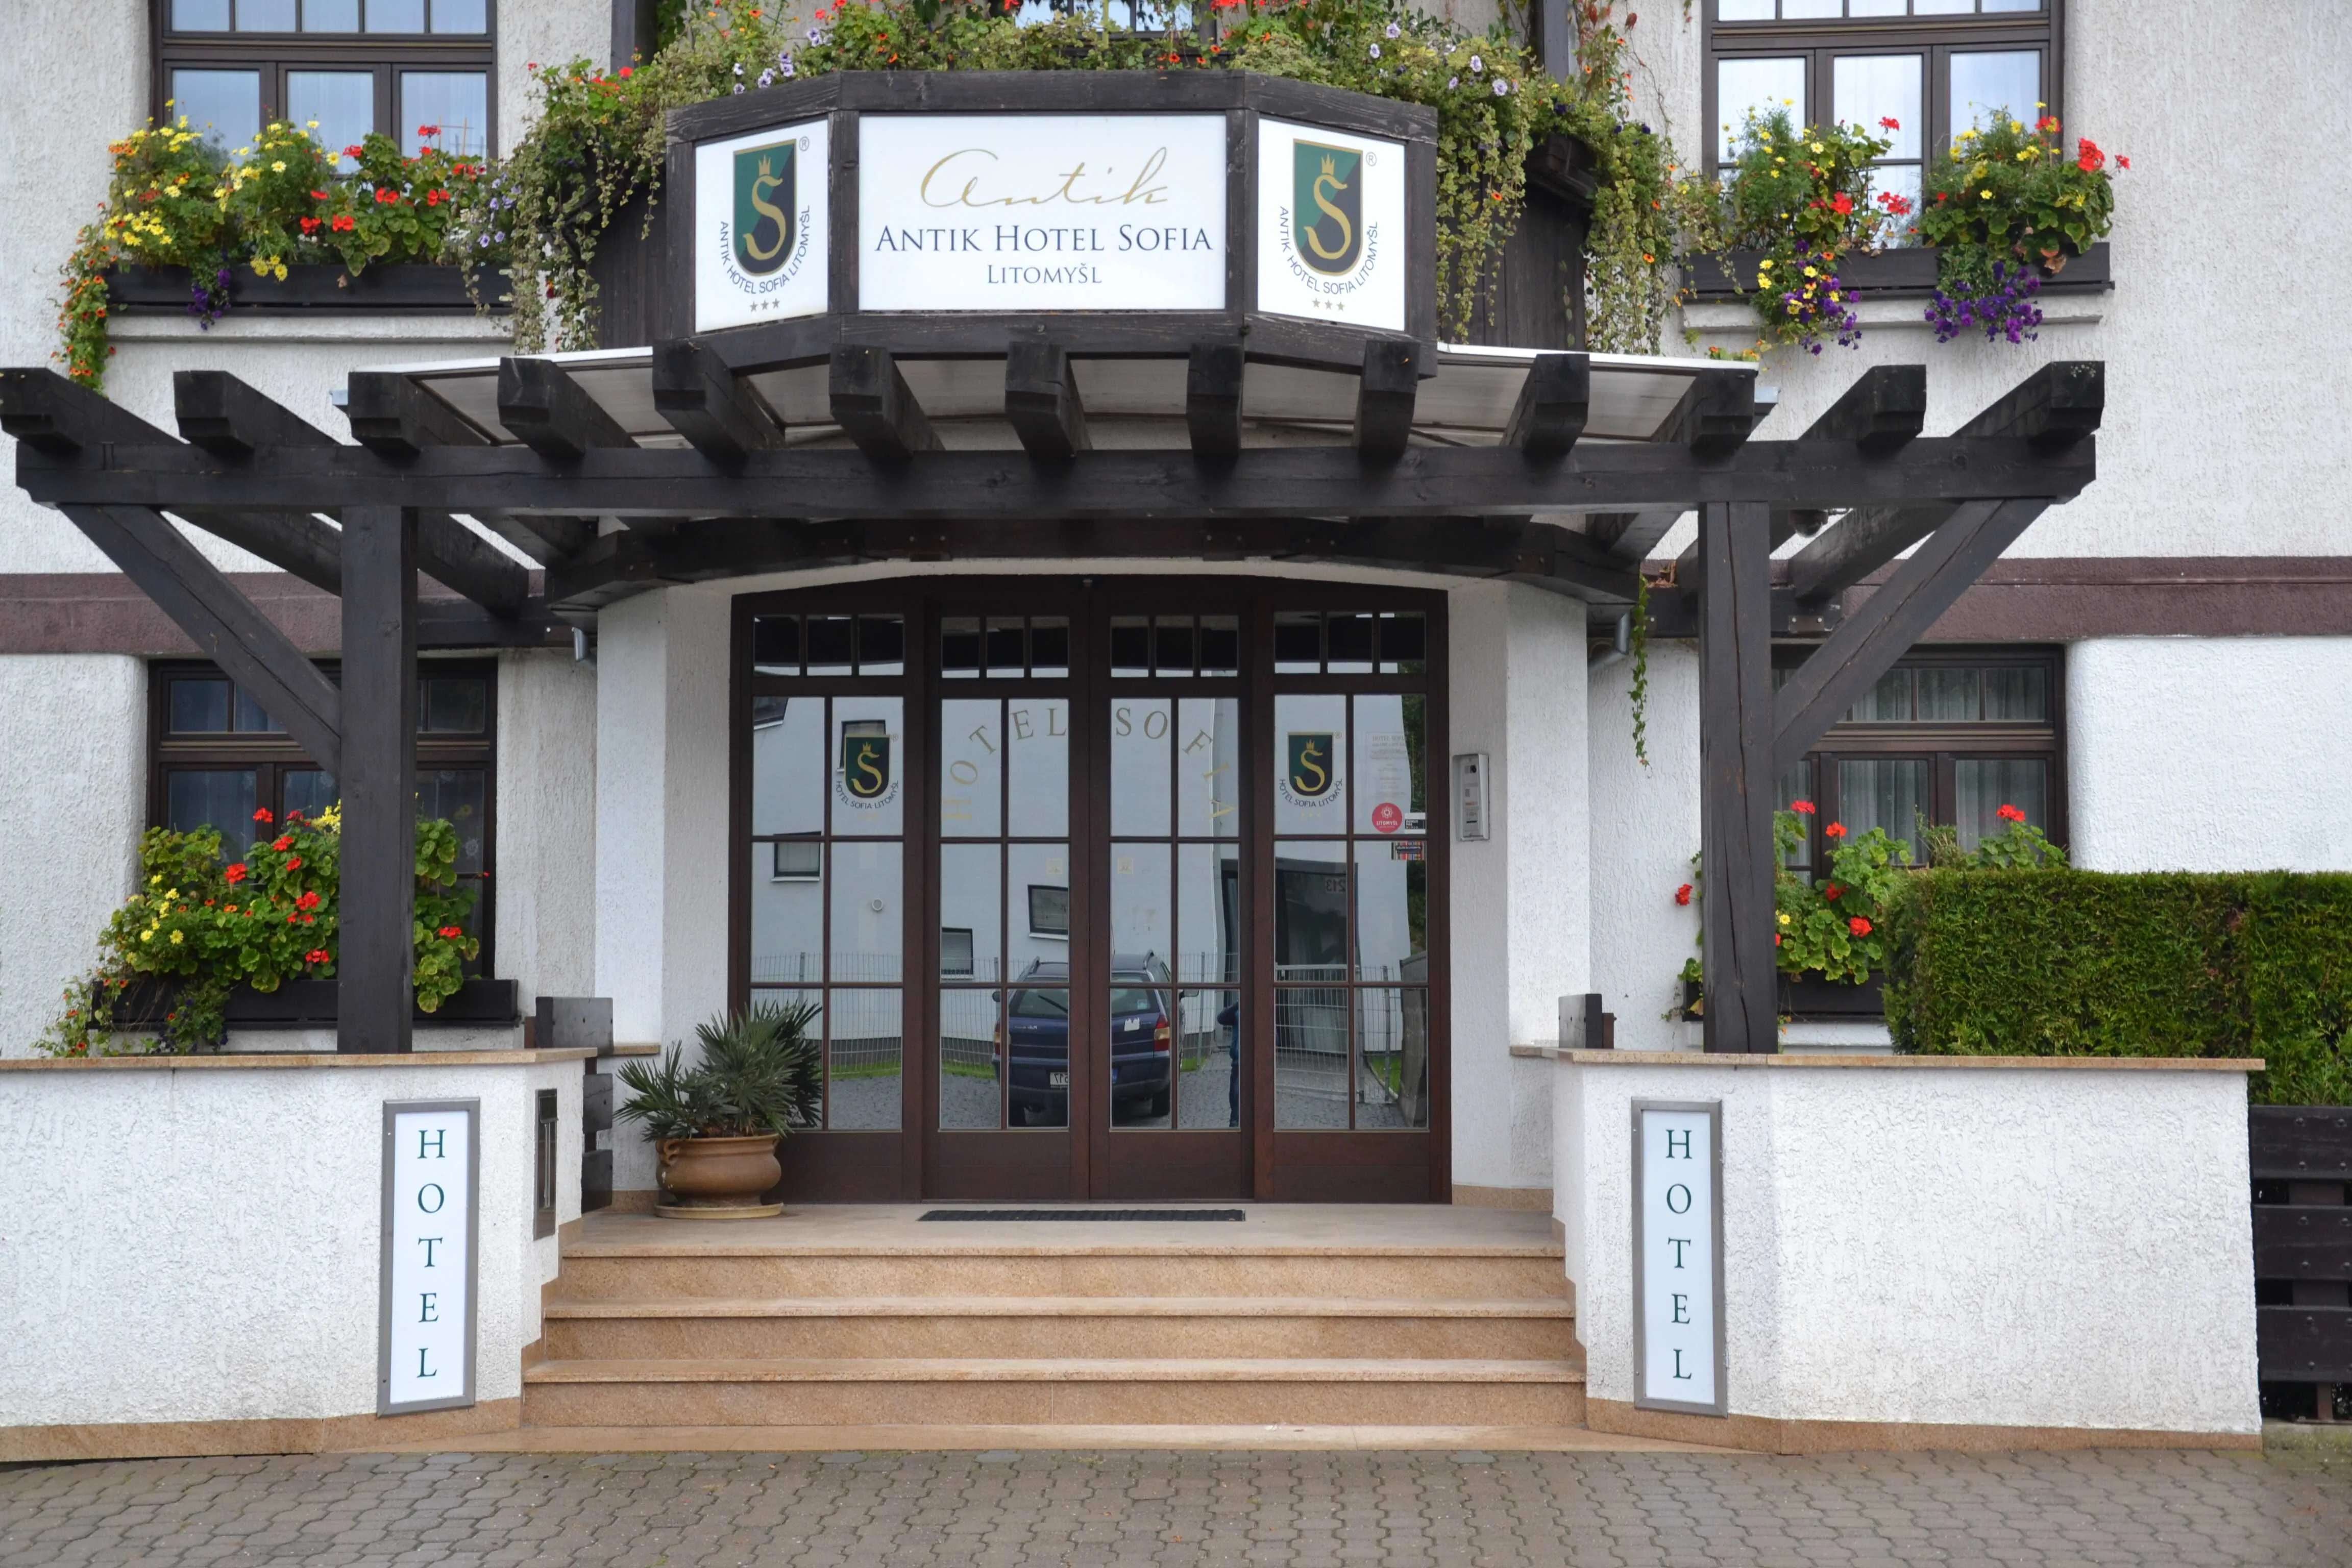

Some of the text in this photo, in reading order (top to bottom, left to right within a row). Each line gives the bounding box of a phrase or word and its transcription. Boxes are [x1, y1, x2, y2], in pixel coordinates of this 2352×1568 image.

[720, 205, 810, 295] ANTIK HOTEL SOFIA LITOMYŠL
[874, 224, 1213, 252] ANTIK HOTEL SOFIA
[987, 263, 1102, 284] LITOMYŠL
[1280, 206, 1378, 295] ANTIK HOTEL SOFIA LITOMYŠL
[836, 781, 849, 805] HOTEL
[850, 800, 872, 809] SOFIA
[942, 708, 1067, 819] HOTEL
[1279, 779, 1293, 803] HOTEL
[1294, 799, 1316, 807] SOFIA
[416, 1129, 447, 1378] HOTEL
[1665, 1129, 1693, 1380] HOTEL
